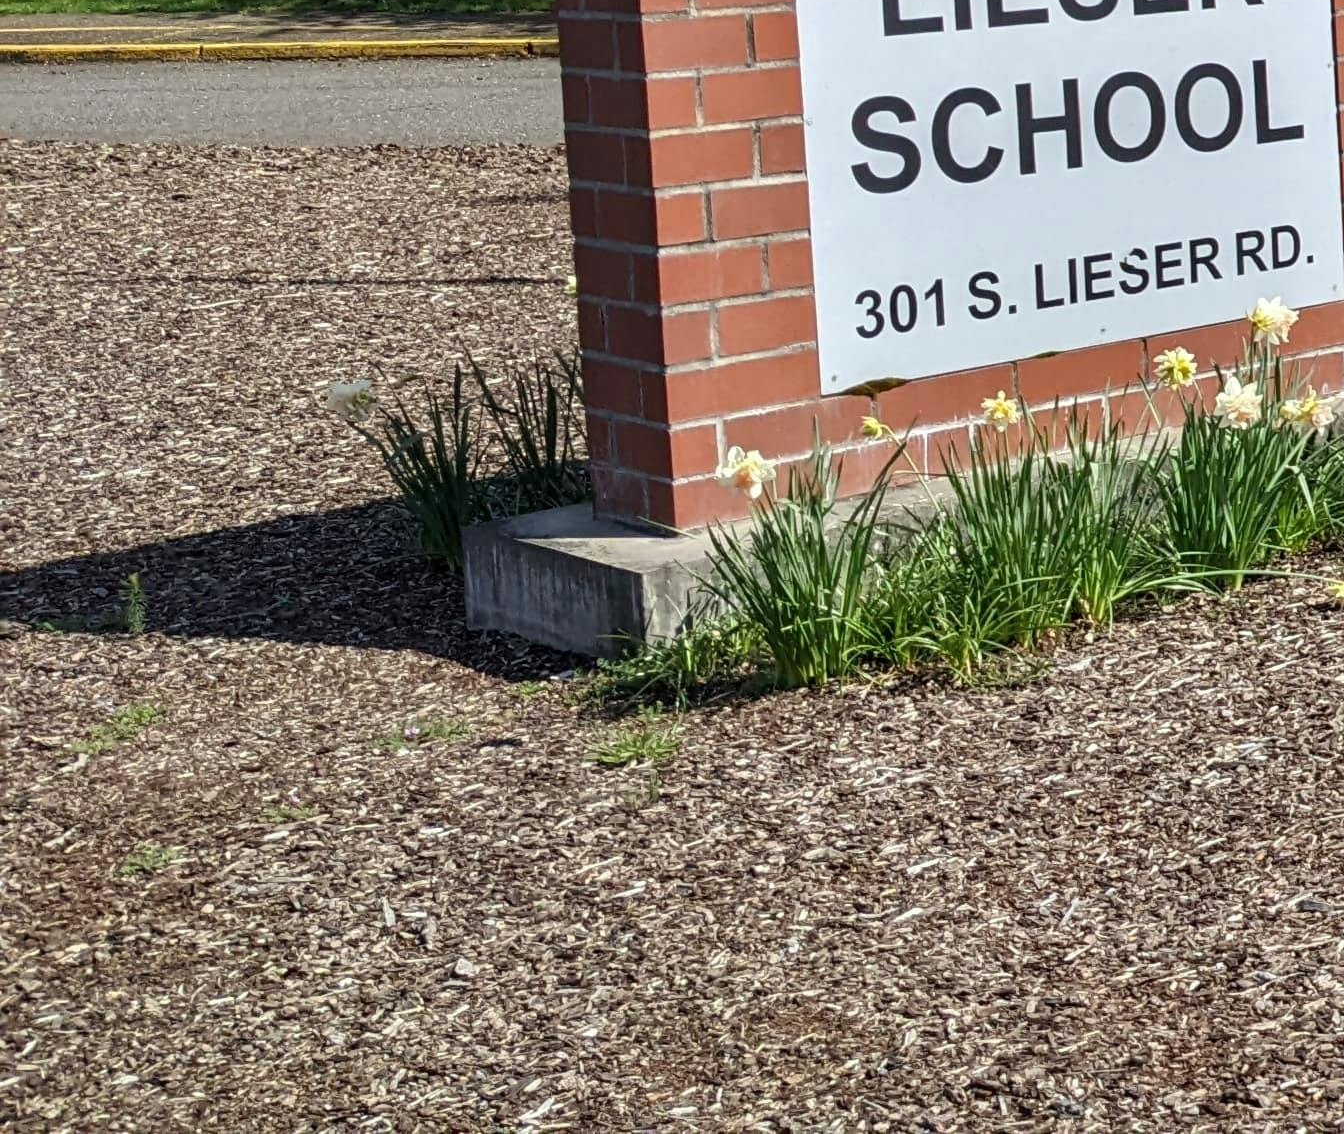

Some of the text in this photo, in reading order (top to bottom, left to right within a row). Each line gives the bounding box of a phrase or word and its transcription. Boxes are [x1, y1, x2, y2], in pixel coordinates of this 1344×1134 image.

[851, 59, 1305, 194] SCHOOL
[855, 224, 1315, 339] 301 S. LIESER RD.
